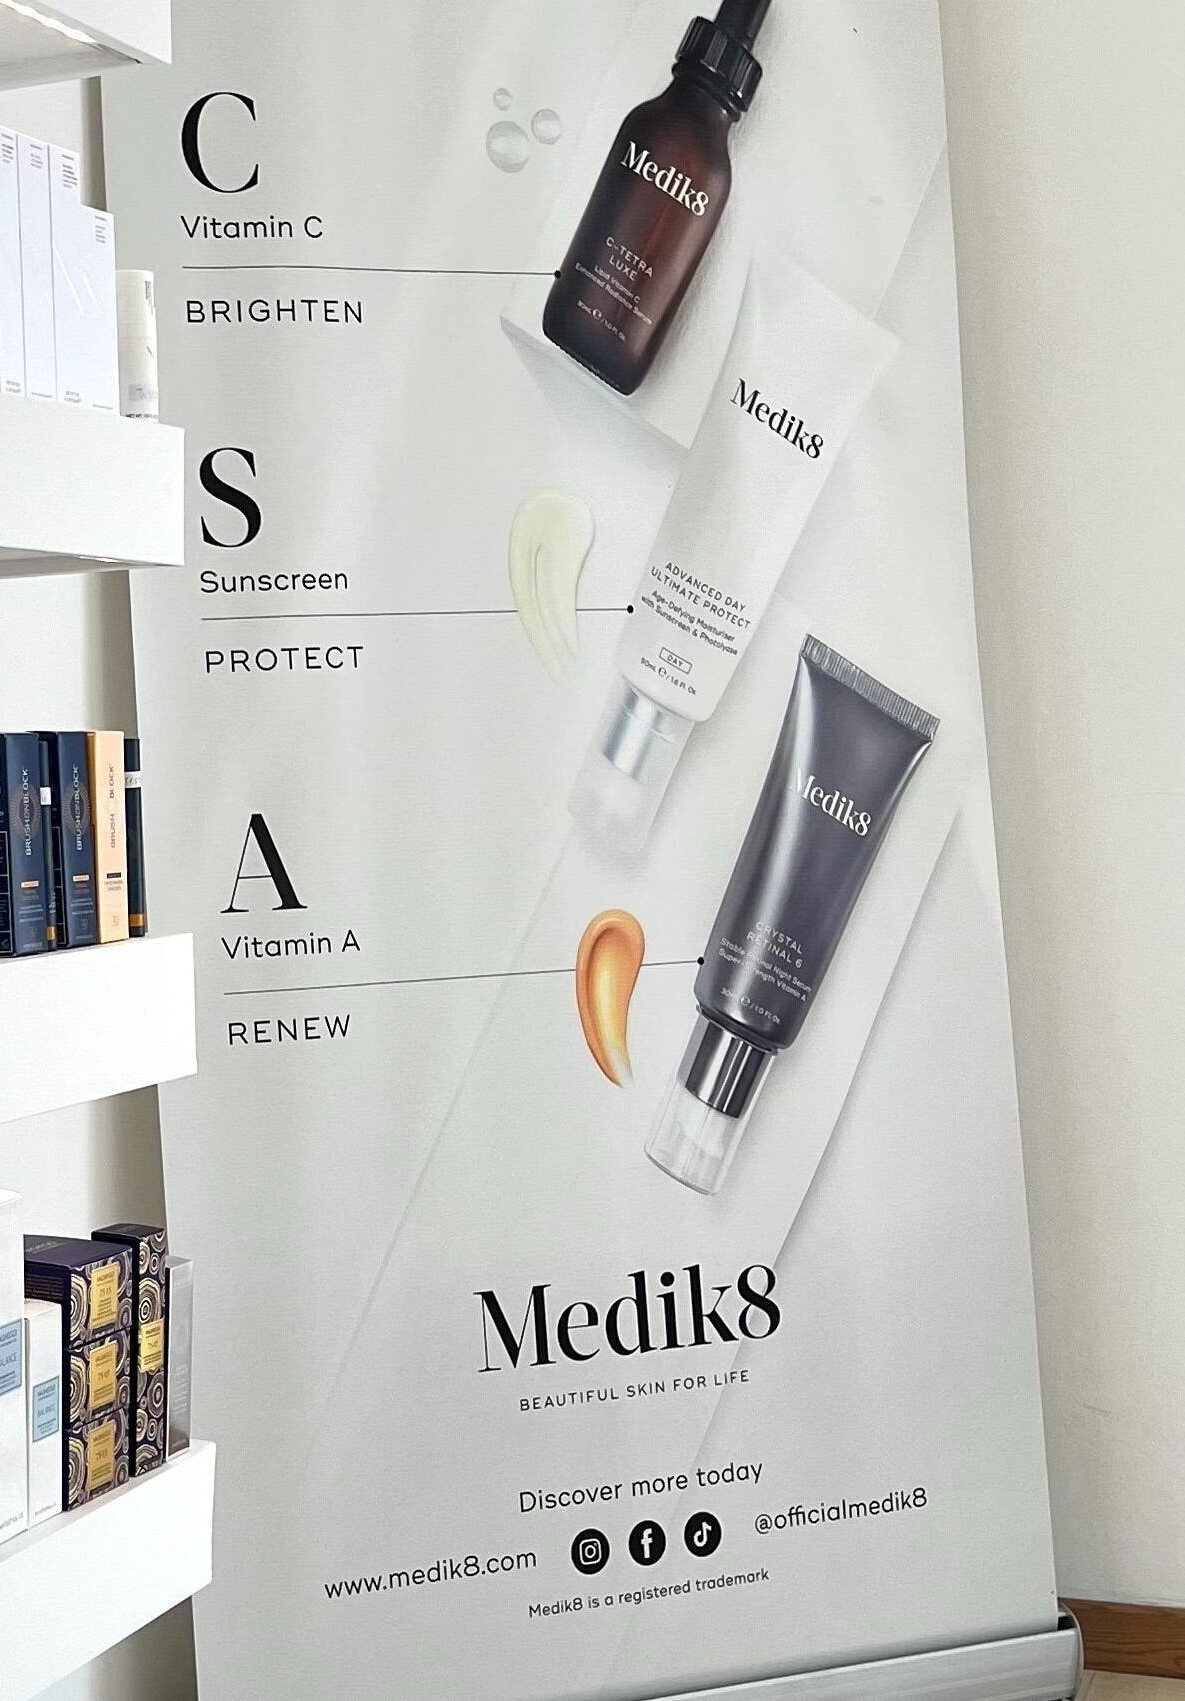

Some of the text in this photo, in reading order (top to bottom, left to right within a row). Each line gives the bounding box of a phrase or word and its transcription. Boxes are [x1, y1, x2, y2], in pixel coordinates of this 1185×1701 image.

[181, 91, 259, 194] C
[620, 140, 710, 217] Medik8
[180, 215, 324, 239] Vitamin C
[605, 236, 654, 278] C-TETRA
[609, 254, 638, 282] LUXE
[186, 299, 363, 323] BRIGHTEN
[729, 378, 825, 460] Medik8
[199, 447, 262, 548] S
[200, 570, 349, 593] Sunscreen
[651, 565, 752, 629] ULTIMATE PROTECT
[665, 561, 747, 613] ADVANCED DAY
[205, 646, 364, 674] PROTECT
[666, 653, 684, 668] DAY
[220, 813, 308, 914] A
[221, 929, 361, 959] Vitamin A
[746, 931, 803, 969] RETINAL 6
[756, 920, 803, 955] CRYSTAL
[228, 1014, 351, 1046] RENEW
[472, 1264, 781, 1374] Medik8
[519, 1368, 751, 1413] BEAUTIFUL SKIN FOR LIFE
[519, 1461, 764, 1514] Discover more today
[752, 1486, 929, 1536] @officialmedik8
[324, 1548, 538, 1600] www.medik8.com
[528, 1567, 771, 1619] Medik8 is a registered trademark
